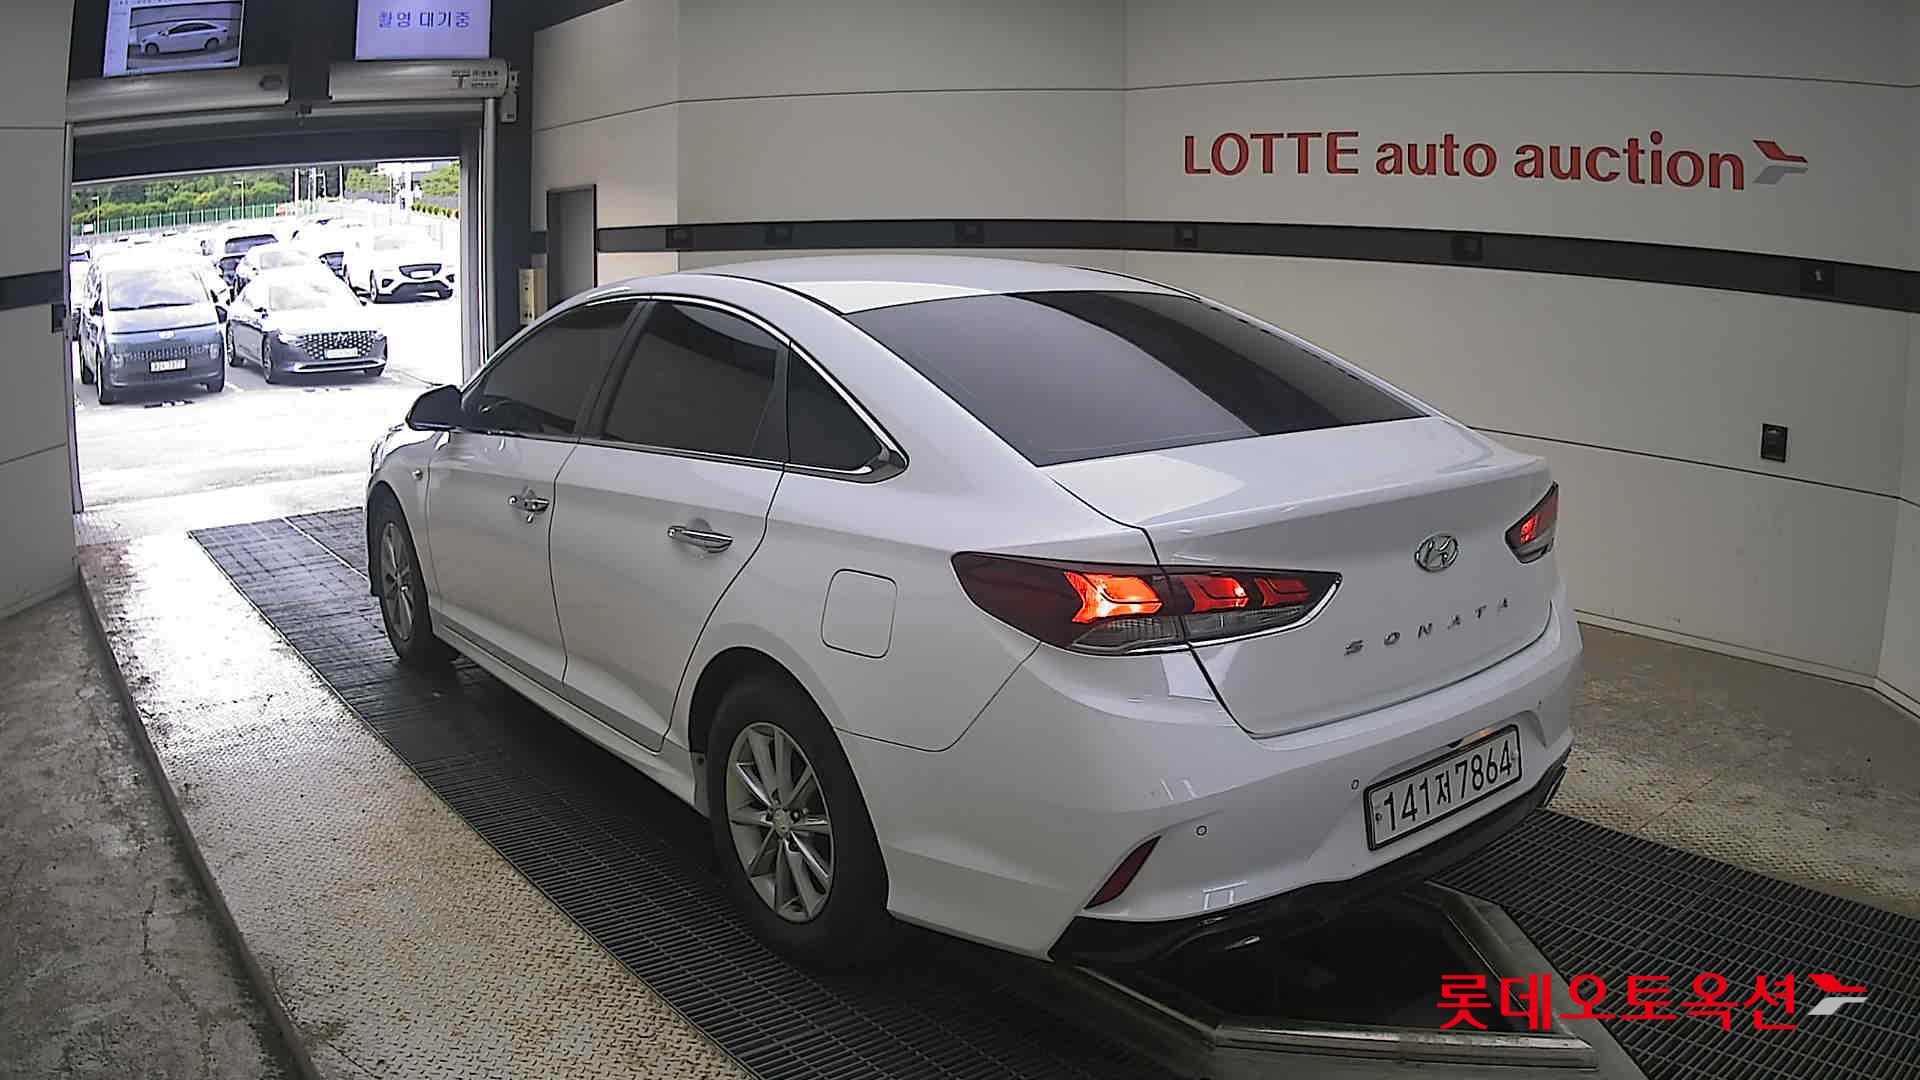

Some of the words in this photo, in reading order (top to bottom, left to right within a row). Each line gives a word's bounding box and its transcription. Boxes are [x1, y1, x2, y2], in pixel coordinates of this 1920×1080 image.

[419, 11, 470, 28] 대기중
[1184, 130, 1359, 176] LOTTE
[1376, 133, 1498, 177] auto
[1513, 131, 1745, 191] auction
[1344, 597, 1509, 656] SONATA
[1383, 739, 1513, 831] 141저7864
